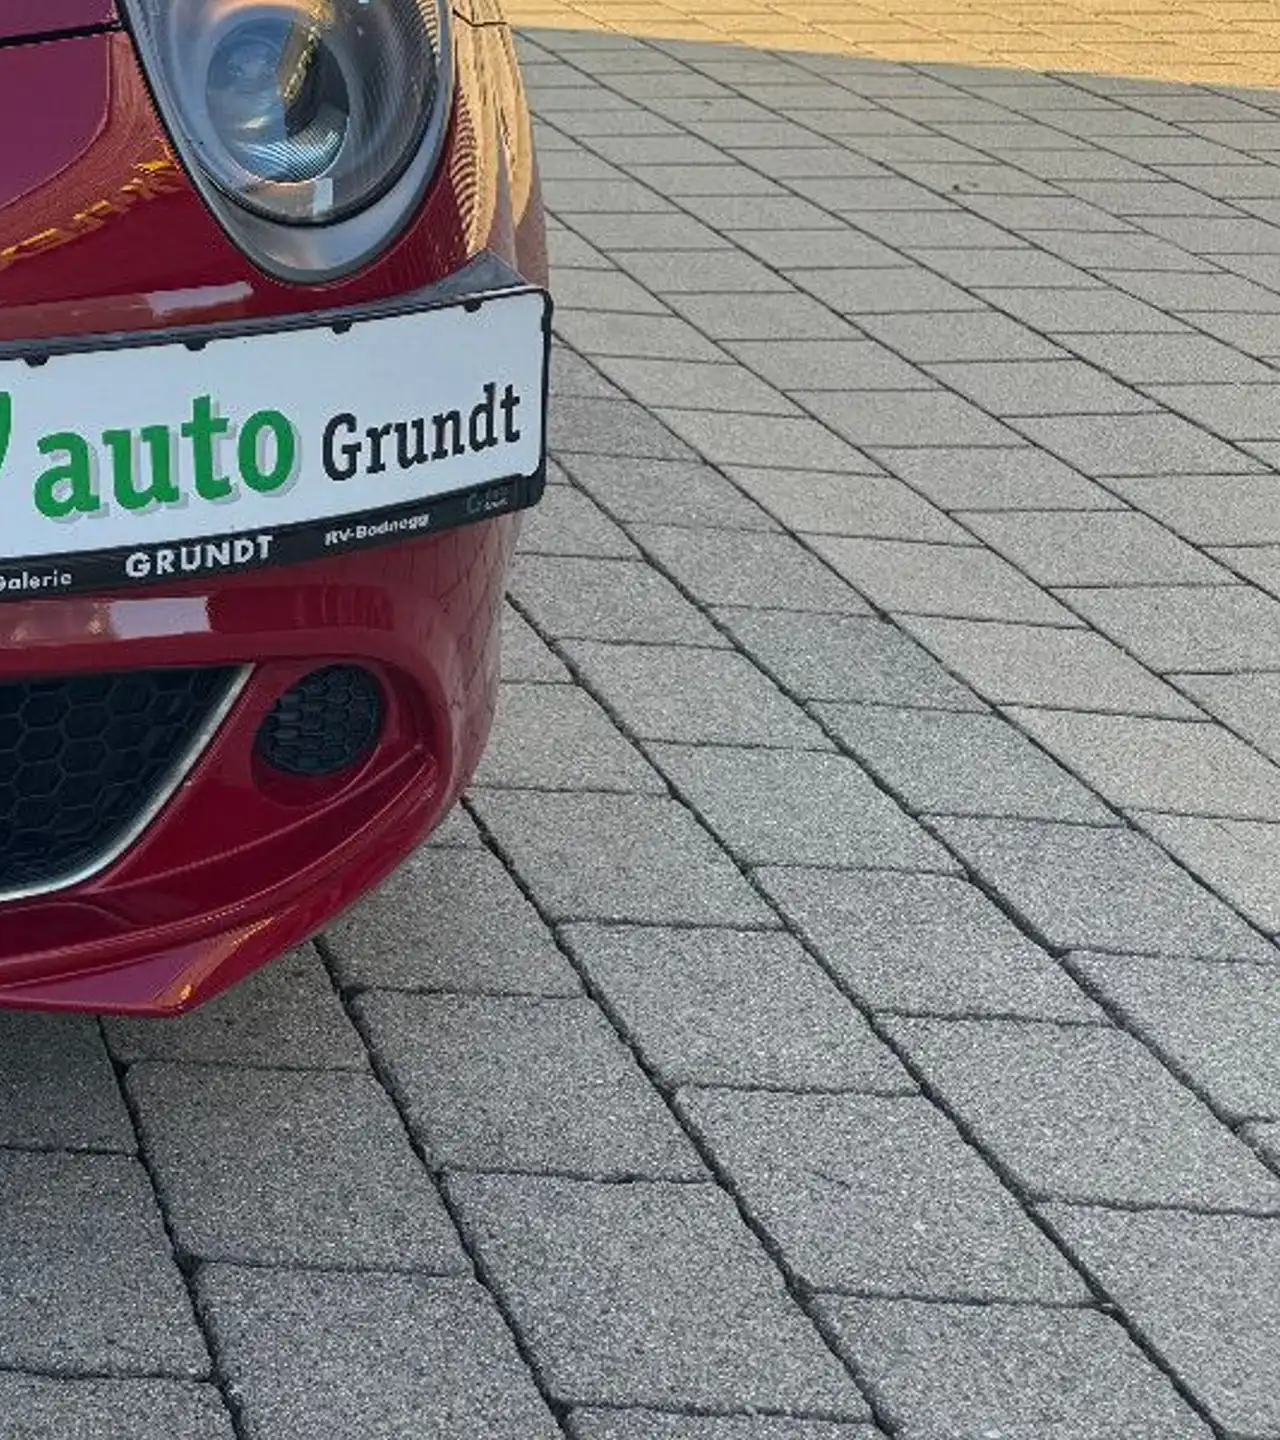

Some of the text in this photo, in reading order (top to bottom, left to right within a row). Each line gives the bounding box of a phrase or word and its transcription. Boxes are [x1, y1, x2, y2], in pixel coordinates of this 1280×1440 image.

[34, 382, 521, 521] auto Grundt
[125, 534, 275, 578] GRUNDT
[324, 512, 431, 547] RV-Bodnegg
